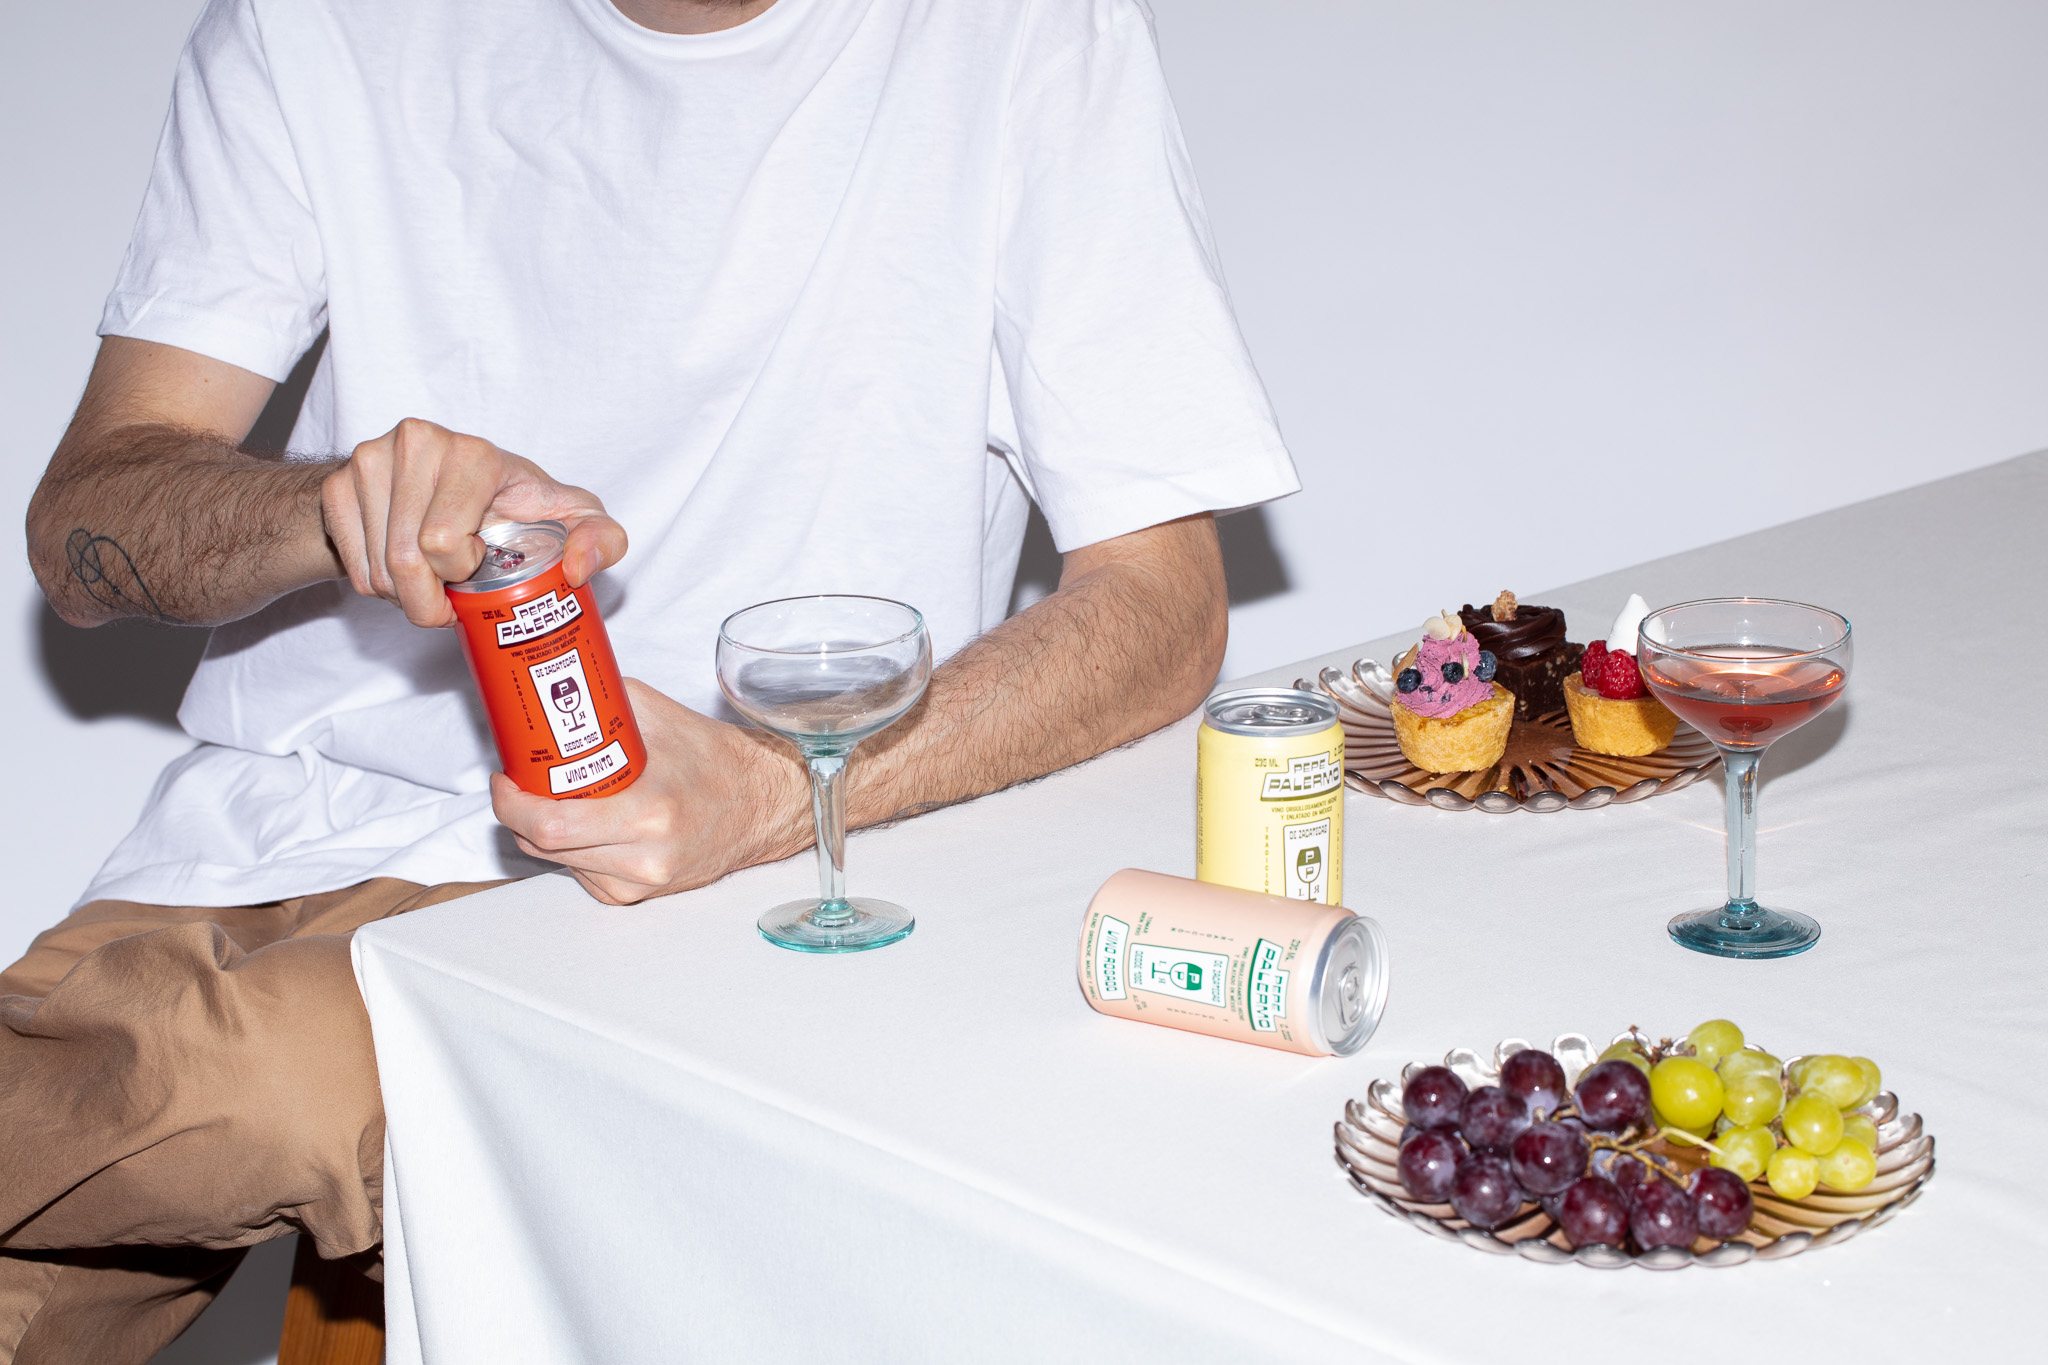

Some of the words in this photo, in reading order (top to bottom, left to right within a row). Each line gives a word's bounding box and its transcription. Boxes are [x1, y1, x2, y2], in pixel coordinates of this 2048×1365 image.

[519, 598, 554, 619] PEPE
[502, 600, 577, 640] PALERMO
[511, 649, 523, 658] VINO
[525, 634, 568, 656] ORGULLOSAMENTE
[567, 625, 581, 638] HECHO
[527, 649, 552, 662] ENLATADO
[560, 636, 577, 650] MÉXICO
[535, 668, 544, 678] DE
[544, 655, 576, 675] ZACATECAS
[564, 697, 574, 709] P
[562, 718, 569, 727] L
[564, 738, 584, 752] DESDE
[565, 766, 587, 783] VINO
[588, 755, 613, 774] TINTO
[1255, 758, 1267, 768] 235
[1294, 758, 1325, 773] PEPE
[1268, 768, 1340, 792] PALERMO
[1286, 802, 1327, 813] ORGULLOSAMENTE
[1286, 812, 1311, 821] ENLATADO
[1289, 831, 1298, 840] DE
[1306, 867, 1314, 878] P
[1105, 930, 1119, 954] VINO
[1104, 956, 1117, 991] ROSADO
[1175, 970, 1185, 980] P
[1256, 947, 1276, 1028] PALERMO
[1272, 976, 1282, 1012] PEPE
